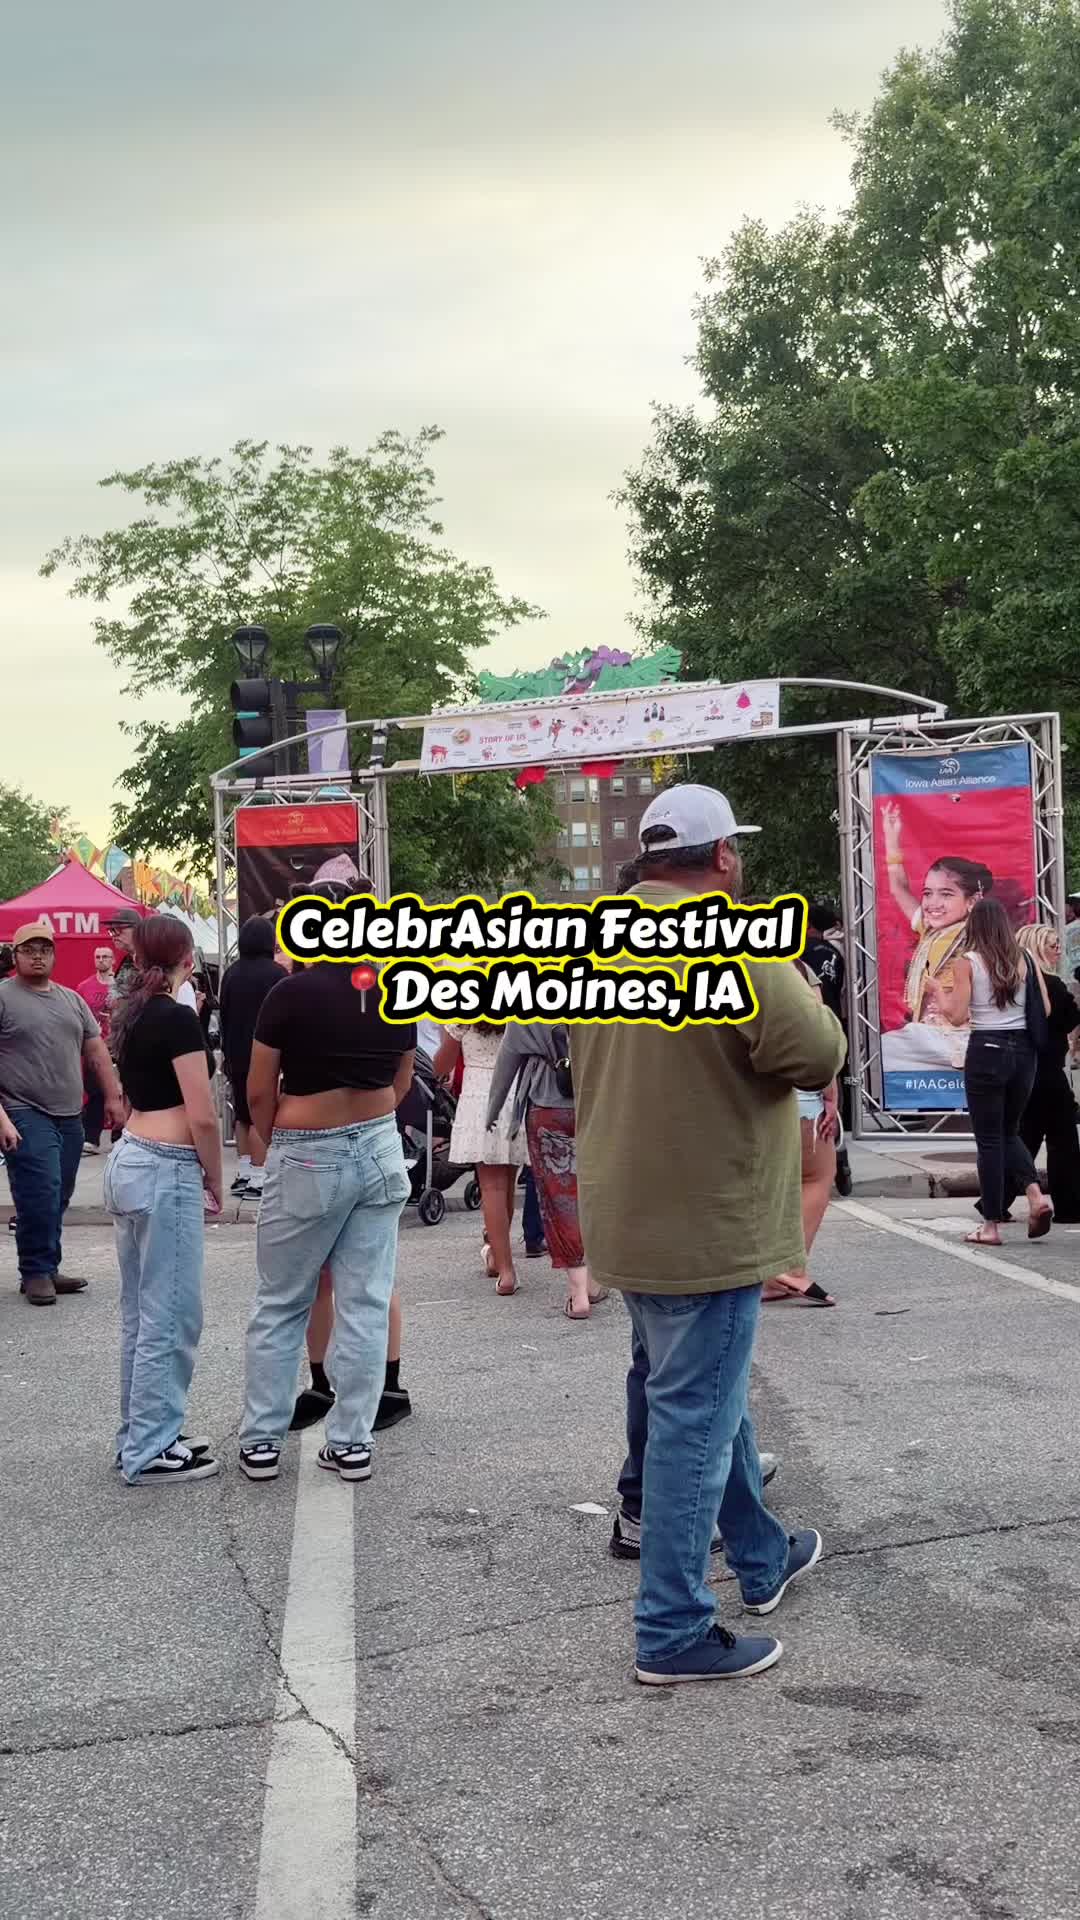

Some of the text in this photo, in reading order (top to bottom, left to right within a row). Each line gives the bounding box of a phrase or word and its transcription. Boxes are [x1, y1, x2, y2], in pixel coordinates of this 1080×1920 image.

[480, 735, 503, 745] STORY
[516, 733, 527, 742] US
[905, 775, 997, 788] Iowa Asian Alliance
[38, 912, 99, 934] ATM
